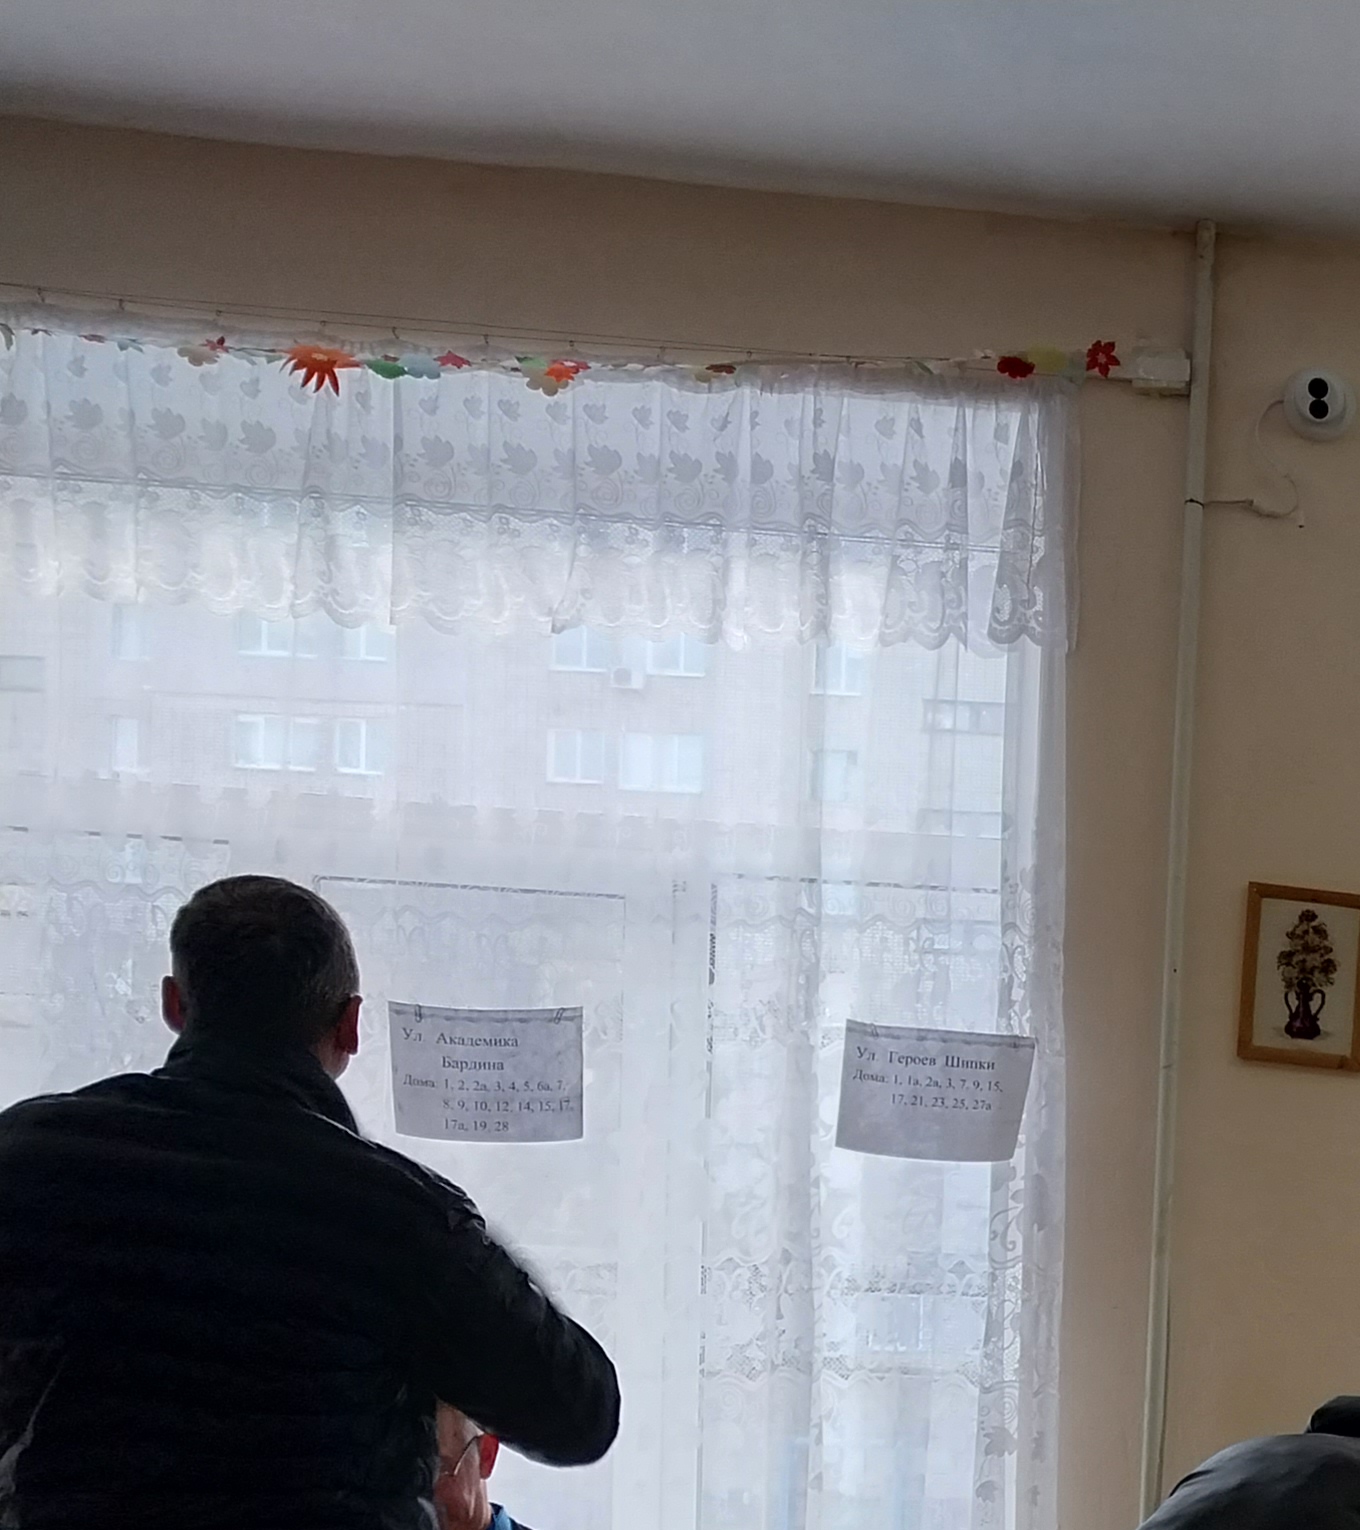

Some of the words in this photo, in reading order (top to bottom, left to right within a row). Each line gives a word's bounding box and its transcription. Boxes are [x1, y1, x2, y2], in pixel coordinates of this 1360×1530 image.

[435, 1033, 519, 1048] Академика
[442, 1056, 504, 1072] Бардина
[889, 1051, 936, 1067] Героев
[945, 1055, 995, 1070] Шипки
[494, 1121, 509, 1132] 28
